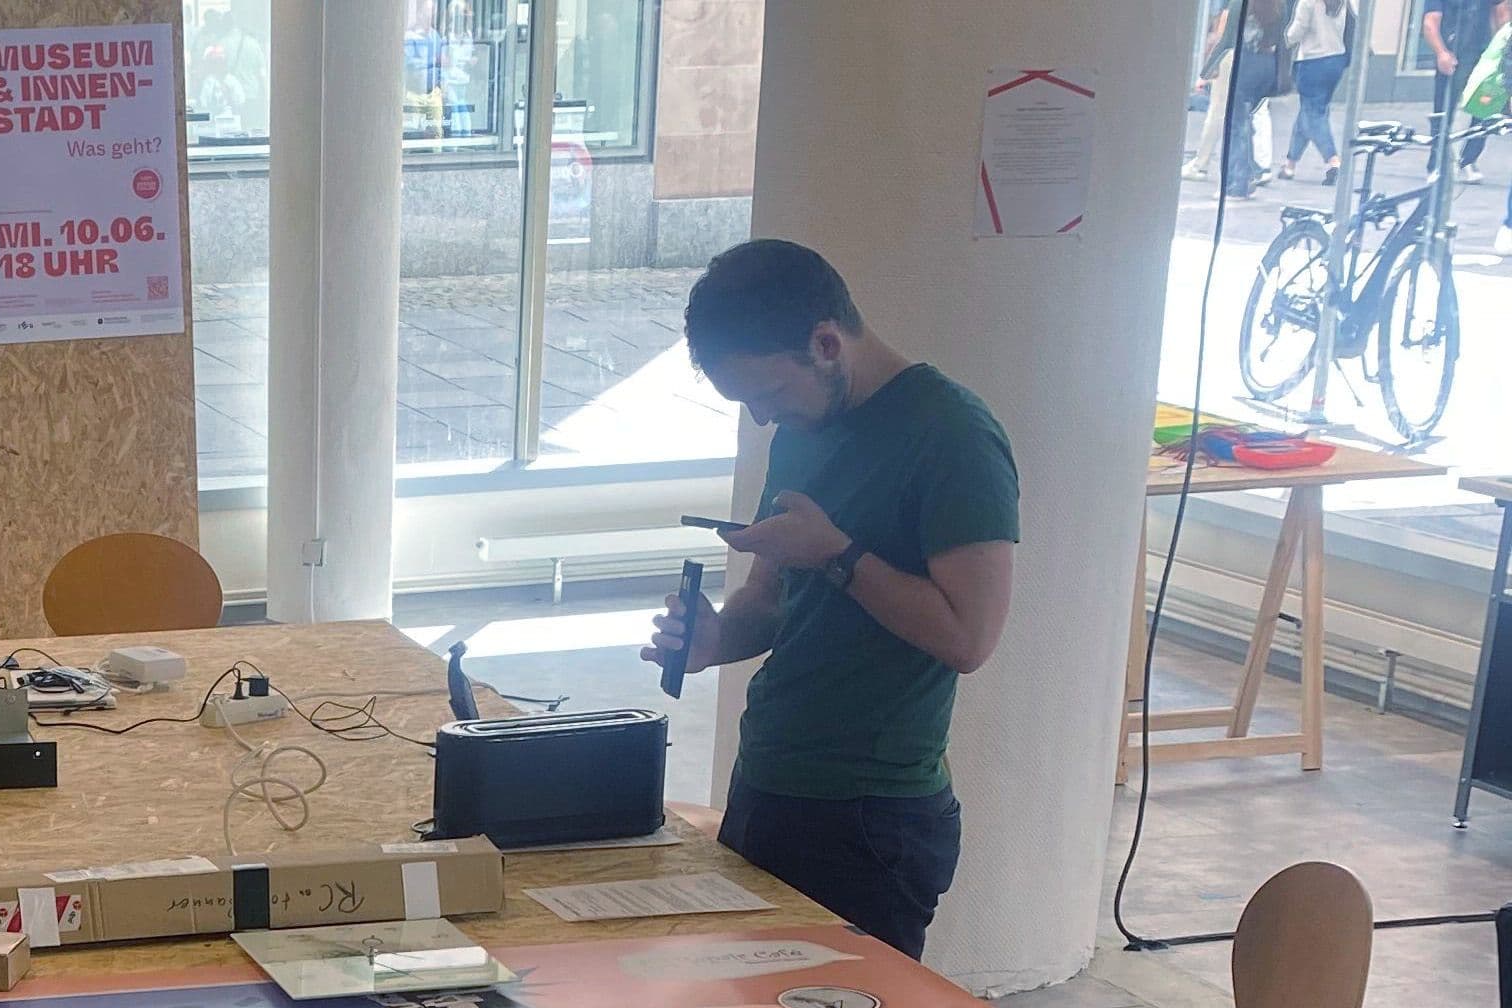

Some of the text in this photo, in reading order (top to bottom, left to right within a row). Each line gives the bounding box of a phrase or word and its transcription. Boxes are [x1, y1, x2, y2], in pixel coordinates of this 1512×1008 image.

[21, 72, 153, 101] INNEN-
[66, 137, 163, 160] Was geht?
[59, 216, 166, 246] 10.06.
[43, 249, 119, 277] UHR
